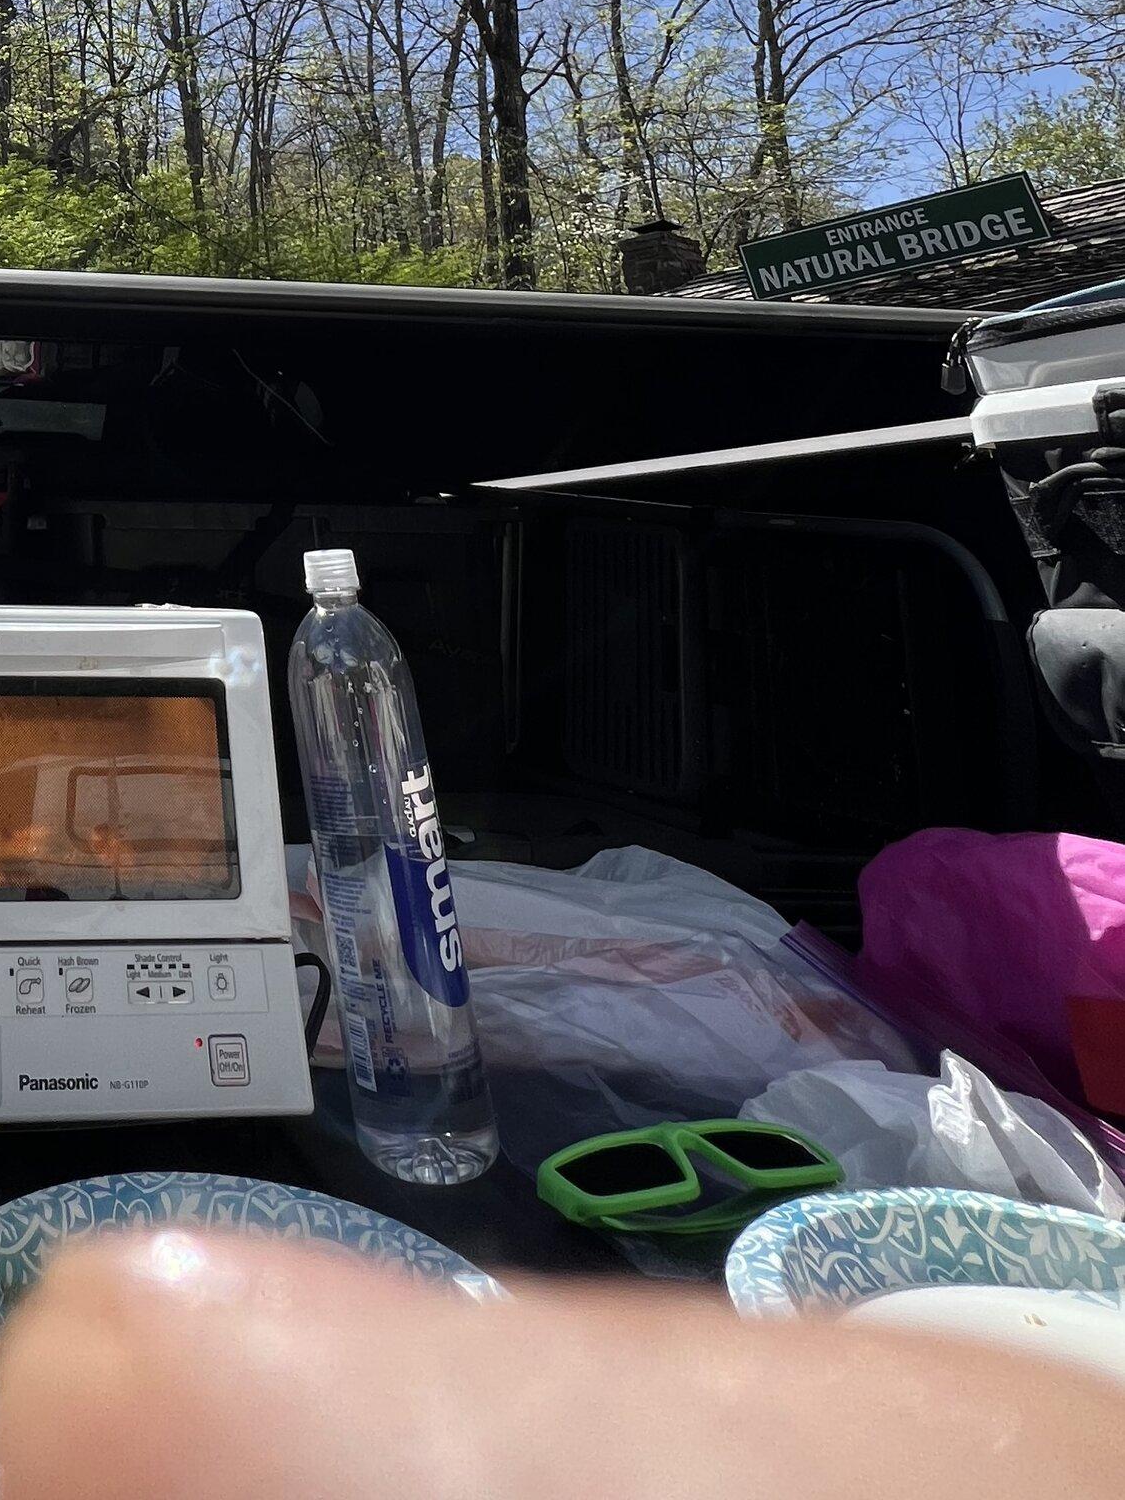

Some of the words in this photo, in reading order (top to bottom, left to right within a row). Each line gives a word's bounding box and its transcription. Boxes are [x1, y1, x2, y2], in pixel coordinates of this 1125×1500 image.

[825, 207, 929, 247] ENTRANCE
[758, 238, 896, 292] NATURAL
[898, 207, 1034, 262] BRIDGE
[401, 765, 463, 972] smart
[17, 956, 41, 967] Quick
[57, 956, 75, 966] Hash
[76, 955, 99, 966] Brown
[134, 953, 156, 963] Shade
[157, 953, 183, 963] Control
[209, 953, 229, 964] Light
[16, 1005, 46, 1015] Reheat
[66, 1003, 96, 1014] Frozen
[377, 984, 394, 1044] RECYCLE
[219, 1049, 241, 1060] Power
[219, 1062, 243, 1073] Off/On
[18, 1073, 99, 1092] Panasonic
